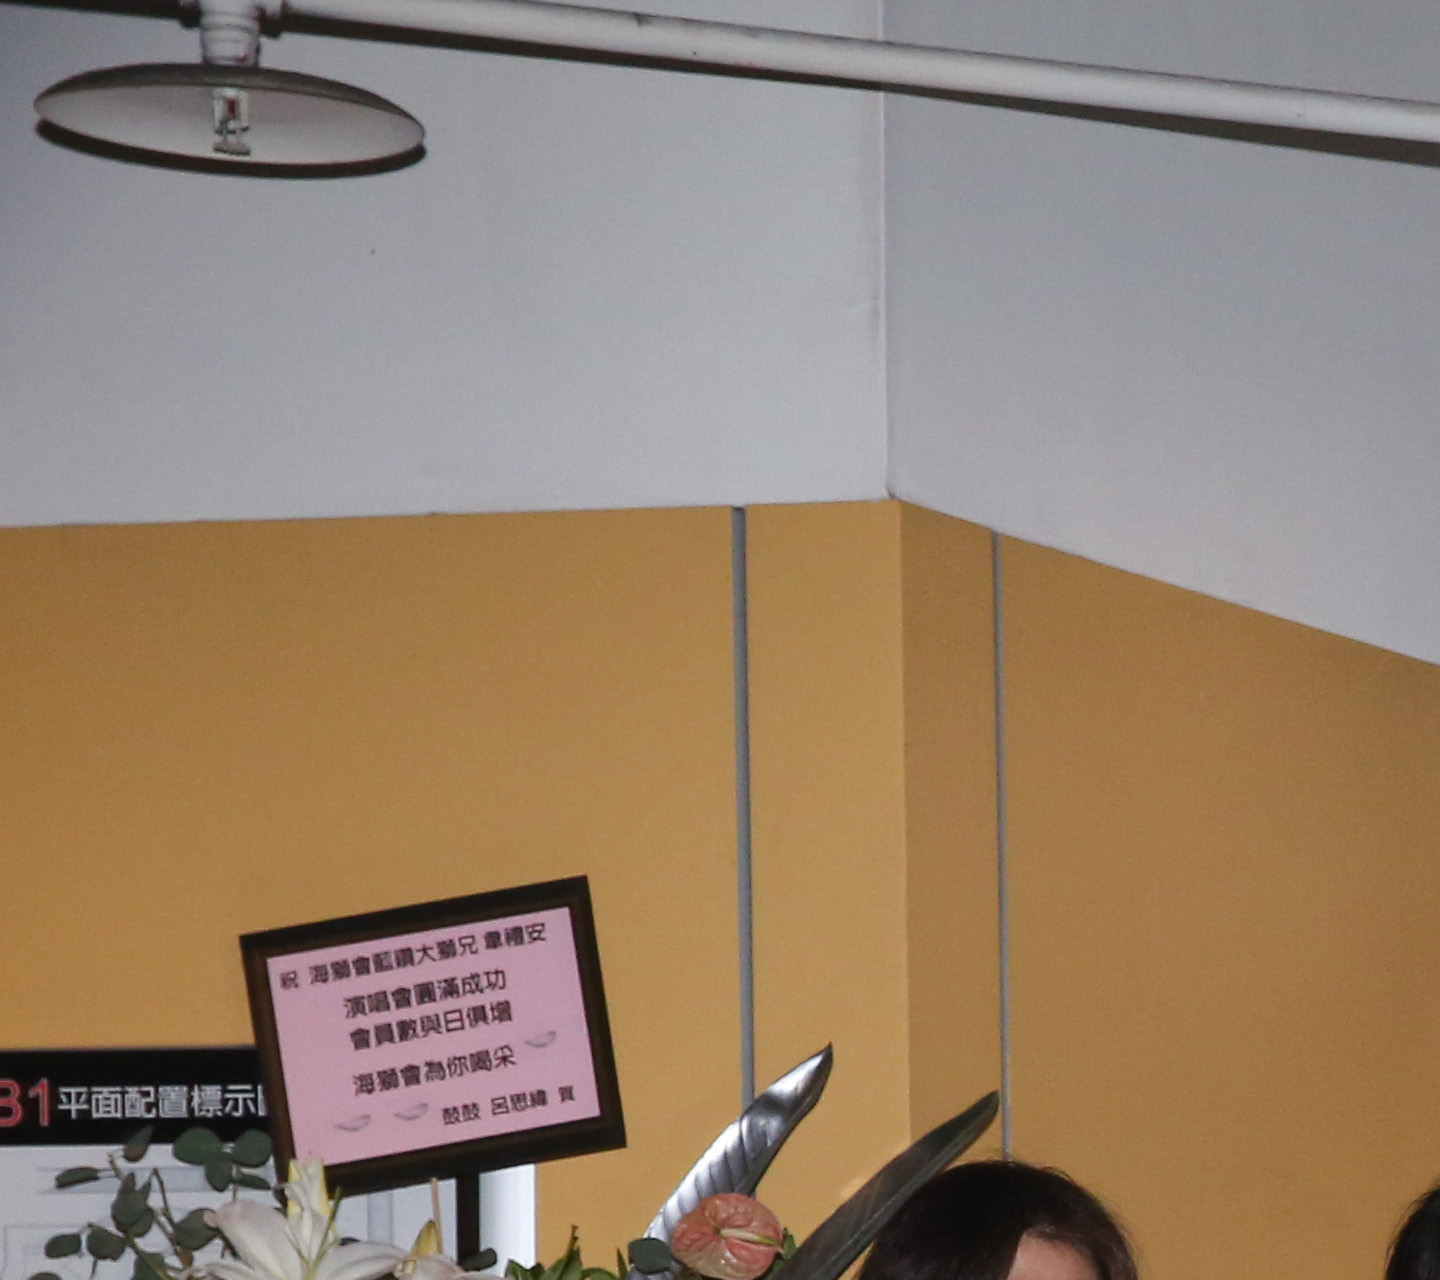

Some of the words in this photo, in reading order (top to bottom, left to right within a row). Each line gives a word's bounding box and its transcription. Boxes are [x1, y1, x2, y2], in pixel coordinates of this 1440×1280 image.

[279, 971, 300, 991] 祝
[343, 969, 507, 1020] 演唱會圓滿成功
[349, 1000, 514, 1051] 會員數與日俱增
[353, 1044, 518, 1098] 海獅會為你喝采
[57, 1083, 268, 1119] 平面配置標示
